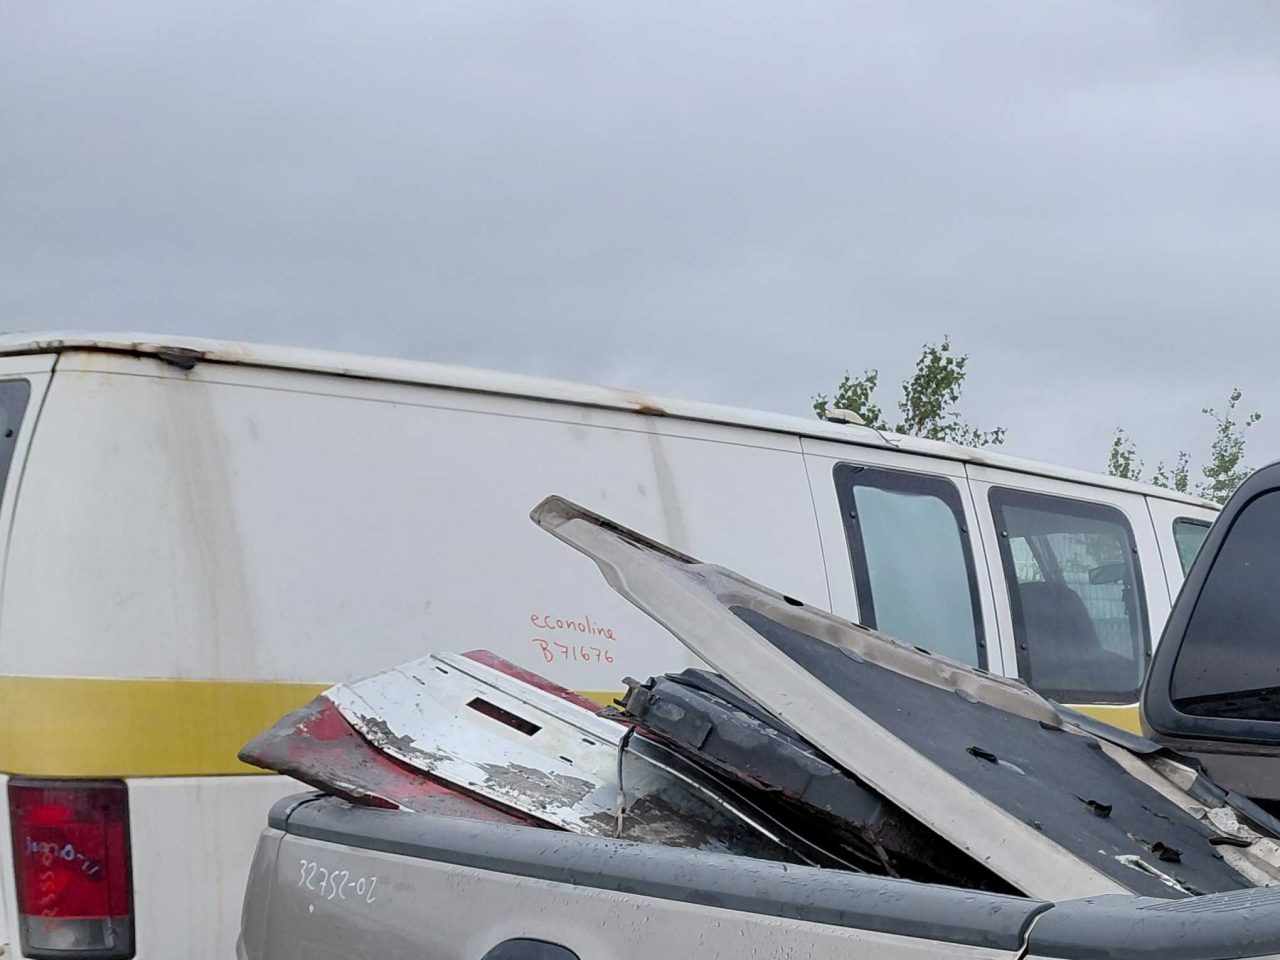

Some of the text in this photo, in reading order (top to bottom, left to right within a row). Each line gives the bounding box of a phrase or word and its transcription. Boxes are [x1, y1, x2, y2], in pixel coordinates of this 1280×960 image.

[530, 614, 616, 640] econoline
[532, 638, 614, 663] B71676
[298, 859, 377, 903] 32752-02
